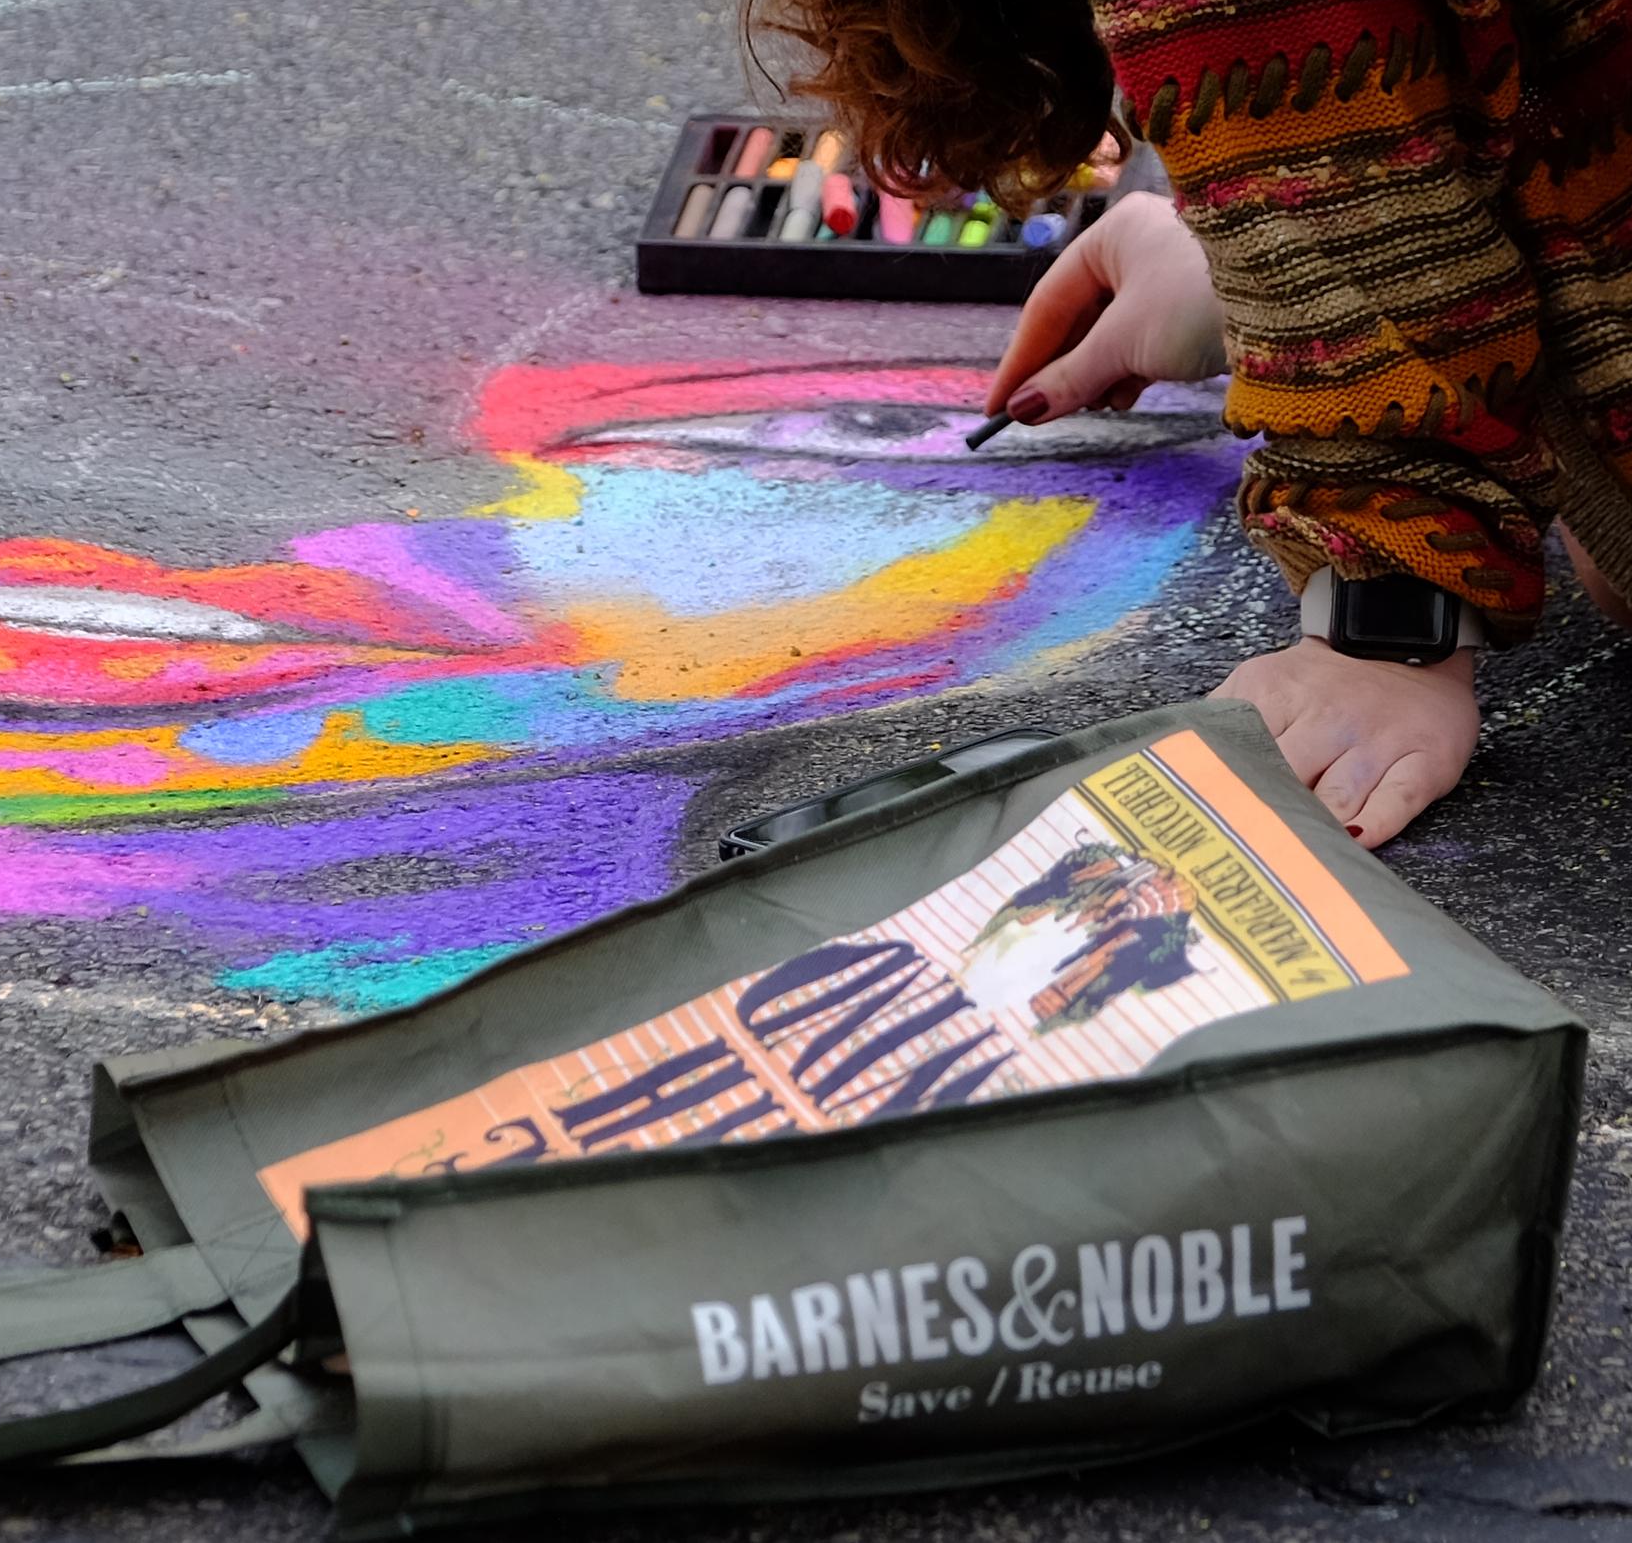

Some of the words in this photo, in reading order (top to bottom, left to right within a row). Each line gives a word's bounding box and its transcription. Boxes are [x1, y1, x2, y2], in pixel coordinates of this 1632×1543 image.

[1102, 762, 1217, 858] MITCHELL
[1190, 850, 1320, 968] MARGARET
[857, 1379, 973, 1424] Save
[1016, 1359, 1163, 1404] Reuse
